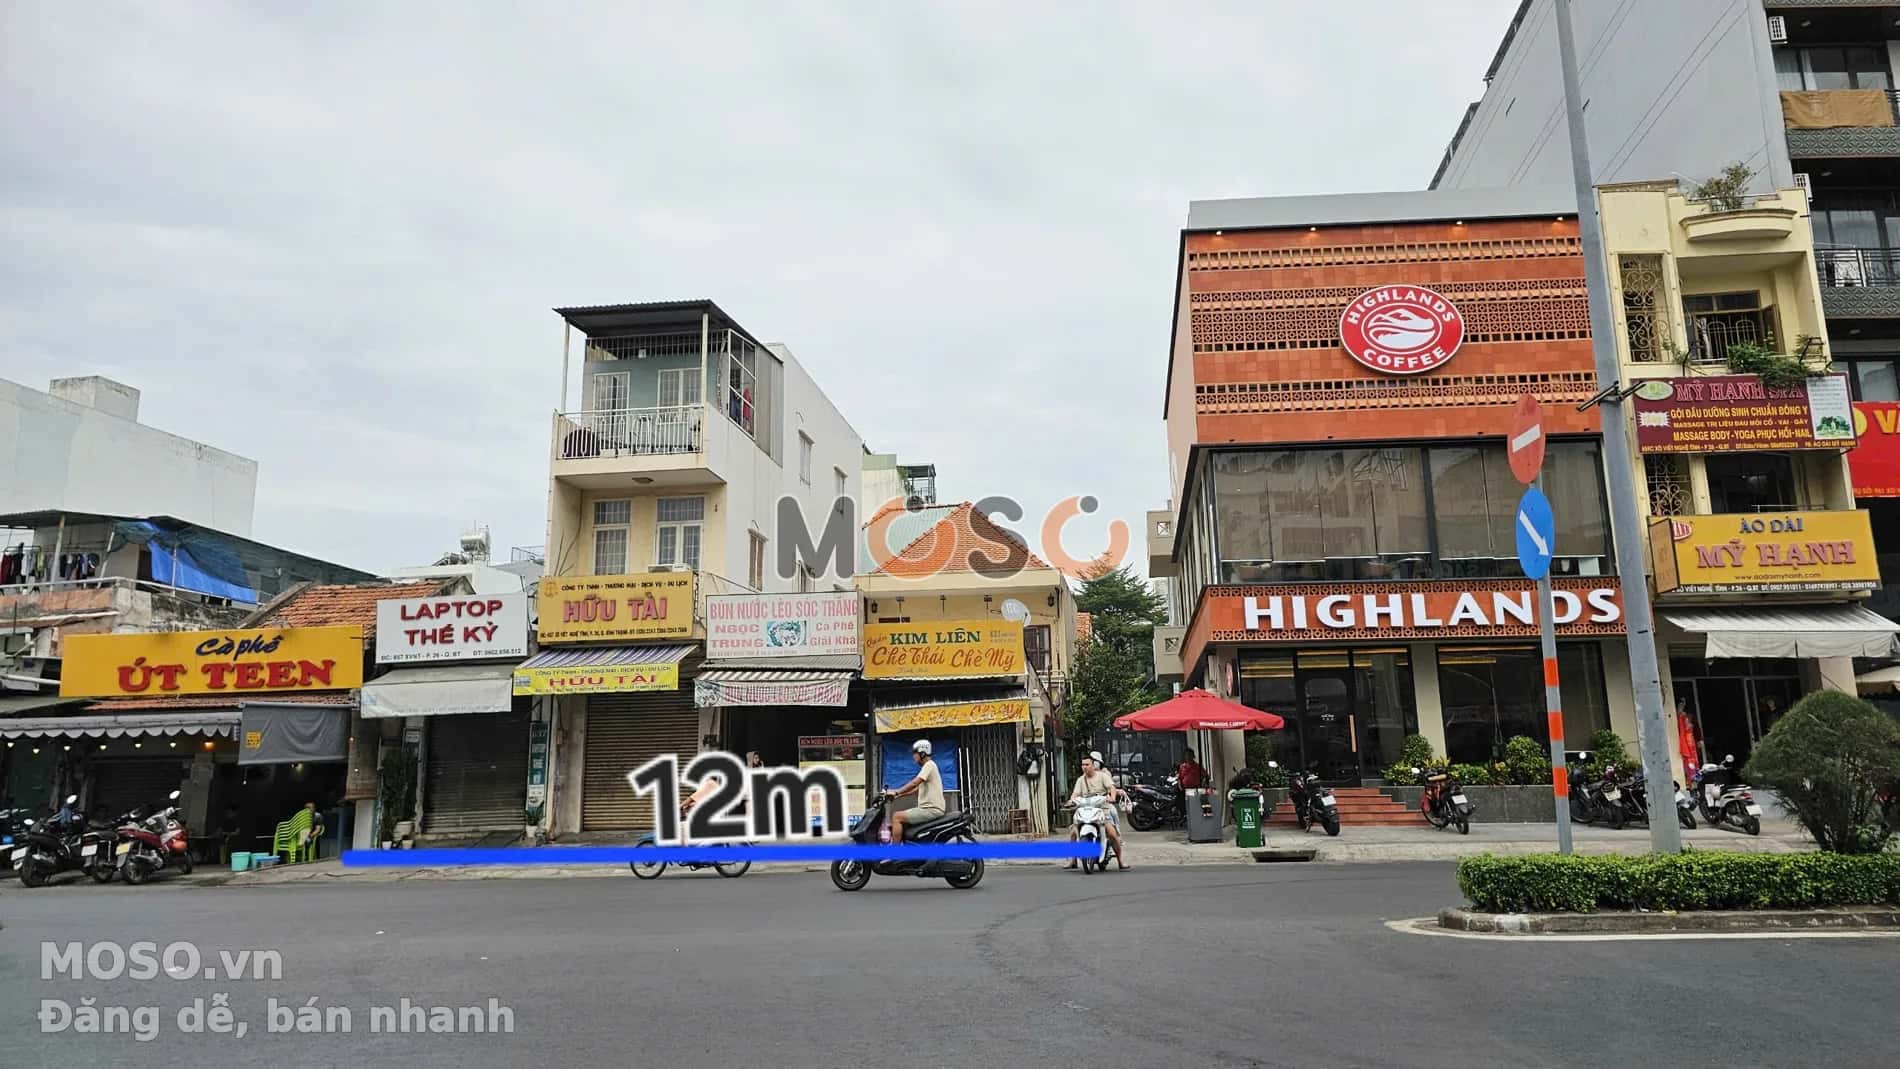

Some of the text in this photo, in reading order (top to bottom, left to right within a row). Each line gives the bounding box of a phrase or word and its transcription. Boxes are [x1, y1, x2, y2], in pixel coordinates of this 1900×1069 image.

[1347, 289, 1455, 324] HIGHLANDS
[1363, 346, 1446, 368] COFFEE
[1709, 382, 1766, 404] HẠNH
[1731, 407, 1749, 416] SINH
[1802, 406, 1808, 415] Y
[1673, 431, 1710, 441] MASSAGE
[1696, 538, 1746, 568] MỸ
[1756, 540, 1856, 570] HẠNH
[400, 599, 503, 621] LAPTOP
[564, 594, 616, 623] HỮU
[710, 599, 734, 620] BÚN
[1244, 588, 1620, 629] HIGHLANDS
[195, 634, 284, 661] Cà phê
[709, 639, 764, 648] TRUNG
[889, 633, 929, 646] KIM
[936, 627, 980, 644] LIÊN
[872, 644, 907, 666] Chè
[951, 648, 983, 667] Chè
[117, 657, 336, 692] ÚT TEEN
